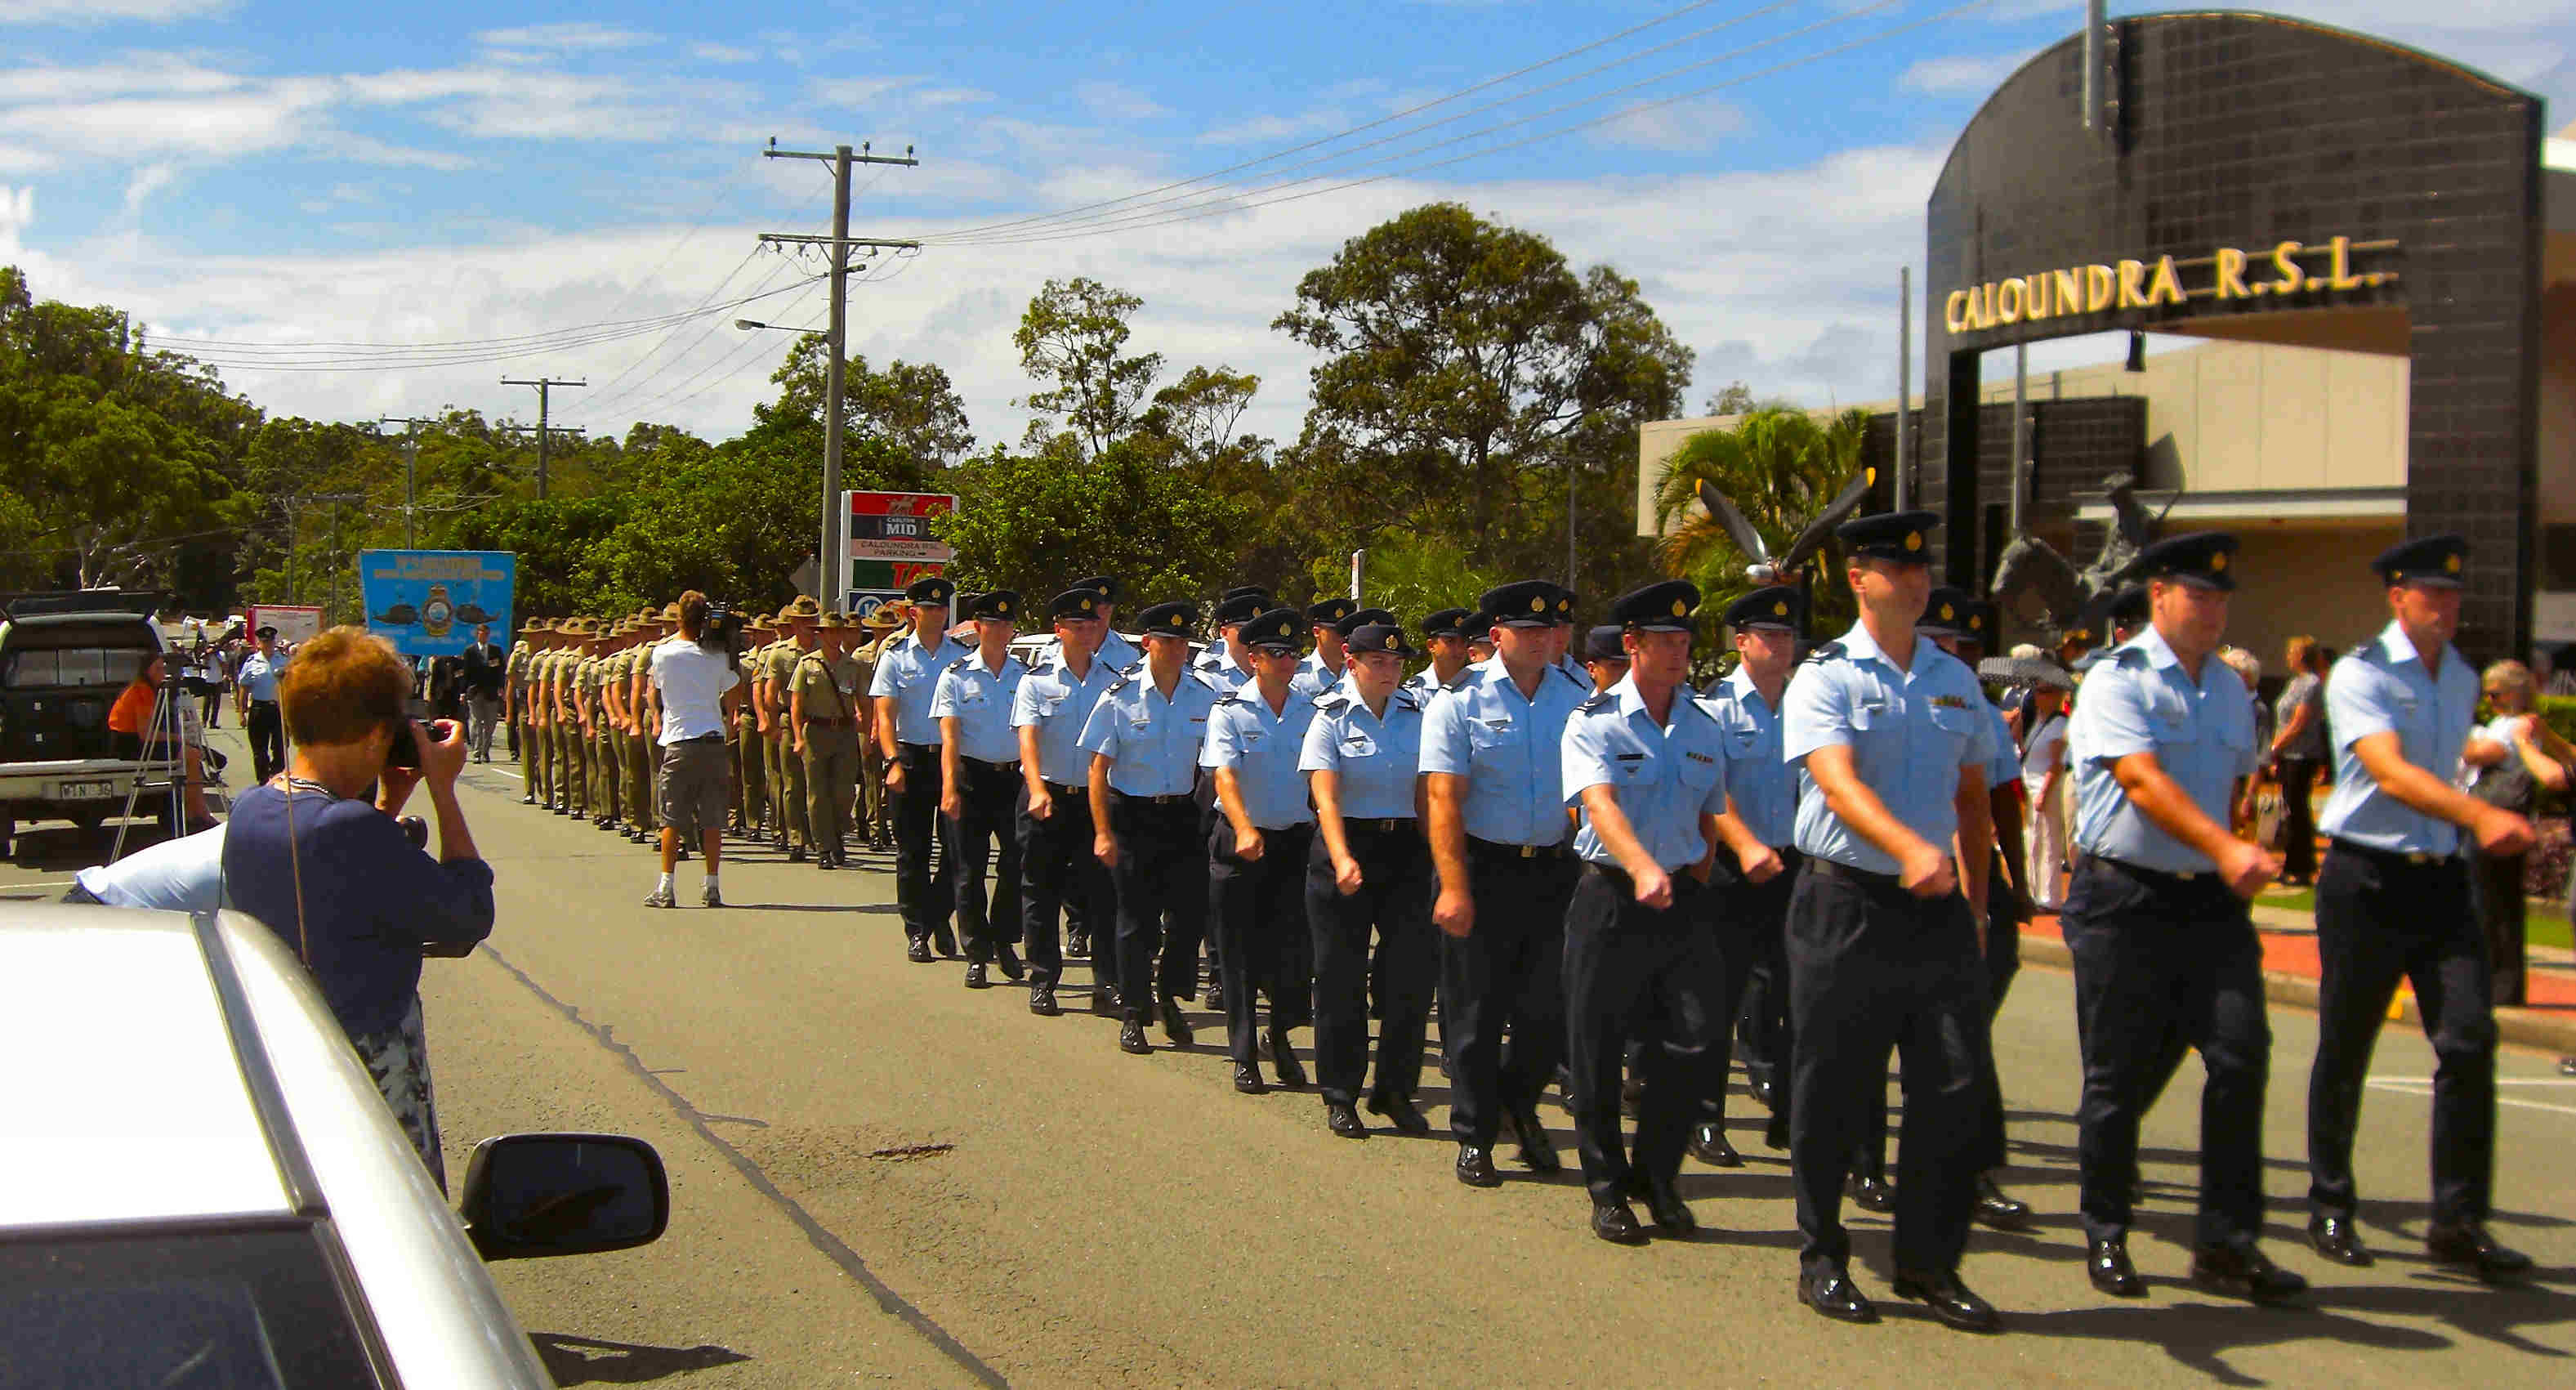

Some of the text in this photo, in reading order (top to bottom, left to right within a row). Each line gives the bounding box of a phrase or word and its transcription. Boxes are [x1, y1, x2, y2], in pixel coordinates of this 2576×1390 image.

[1946, 235, 2384, 334] CALOUNDRA R.S.L.
[886, 524, 917, 536] MID
[861, 541, 920, 550] CALOUNDRA
